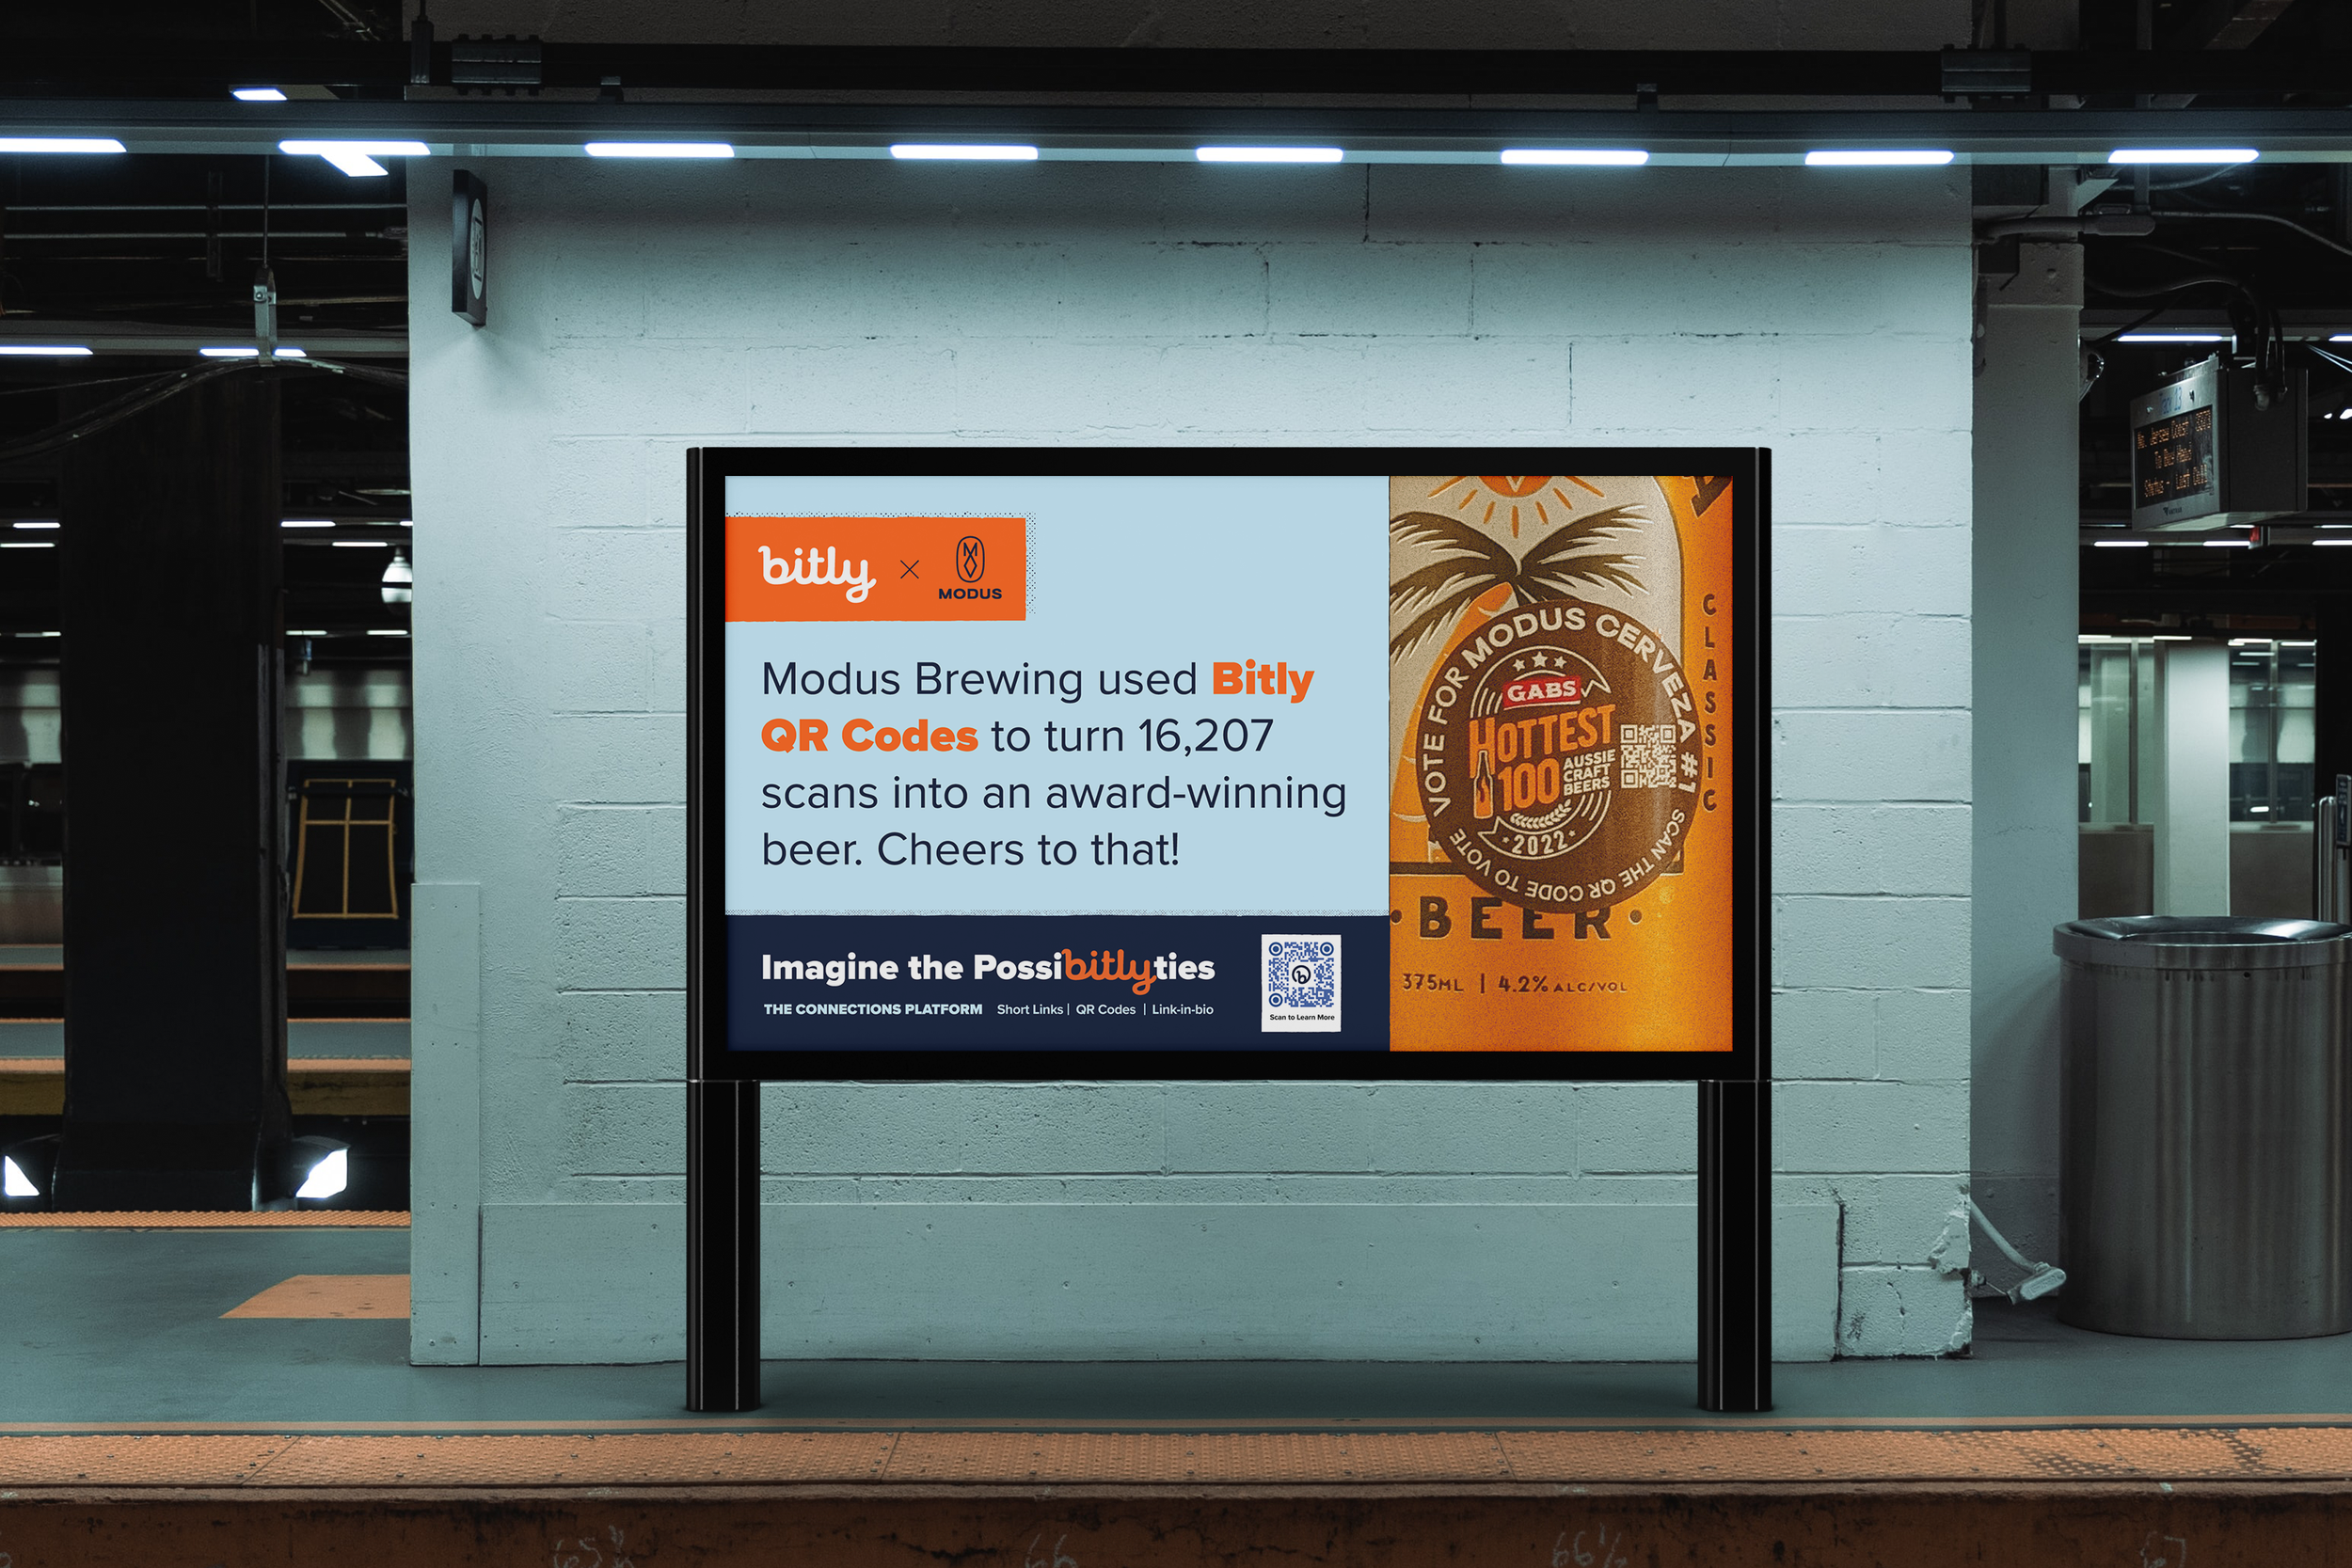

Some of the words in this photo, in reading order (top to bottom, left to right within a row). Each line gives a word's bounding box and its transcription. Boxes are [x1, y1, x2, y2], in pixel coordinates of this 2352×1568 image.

[758, 546, 877, 603] bitly
[939, 588, 1002, 599] MODUS
[1461, 608, 1586, 669] MODUS
[764, 662, 899, 695] Modus
[917, 662, 1081, 704] Brewing
[1100, 662, 1196, 695] used
[1214, 658, 1314, 704] Bitly
[1428, 666, 1469, 725] FOR
[1507, 680, 1577, 703] GABS
[1596, 614, 1696, 743] CERVEZA
[1701, 593, 1718, 813] CLASSIC
[761, 719, 828, 753] QR
[842, 719, 978, 752] Codes
[991, 721, 1030, 752] to
[1044, 721, 1122, 752] turn
[1139, 719, 1273, 757] 16,207
[1469, 705, 1616, 779] HOTTEST
[1423, 734, 1451, 817] VOTE
[1563, 749, 1616, 770] AUSSIE
[1563, 763, 1611, 783] CRAFT
[1678, 752, 1698, 793] #1
[762, 784, 878, 809] scans
[894, 776, 967, 809] into
[983, 784, 1029, 809] an
[1047, 776, 1345, 817] award-winning
[1498, 758, 1560, 811] 100
[1563, 776, 1611, 796] BEERS
[764, 832, 862, 865] beer.
[878, 832, 1024, 865] Cheers
[1038, 835, 1077, 865] to
[1091, 832, 1178, 865] that!
[1449, 828, 1492, 877] VOTE
[1512, 831, 1568, 855] 2022
[1651, 809, 1686, 861] SCAN
[1495, 869, 1519, 892] TO
[1588, 878, 1616, 898] QR
[1618, 858, 1655, 888] THE
[1525, 880, 1584, 902] CODE
[1419, 896, 1611, 939] BEER
[763, 952, 898, 987] Imagine
[908, 955, 963, 980] the
[975, 949, 1216, 995] Possibitlyties
[1403, 974, 1464, 992] 375ML
[764, 1004, 792, 1015] THE
[796, 1004, 901, 1015] CONNECTIONS
[905, 1004, 982, 1015] PLATFORM
[997, 1004, 1029, 1015] Short
[1033, 1004, 1063, 1015] Links
[1076, 1004, 1095, 1015] QR
[1098, 1004, 1136, 1015] Codes
[1152, 1004, 1214, 1015] Link-in-bio
